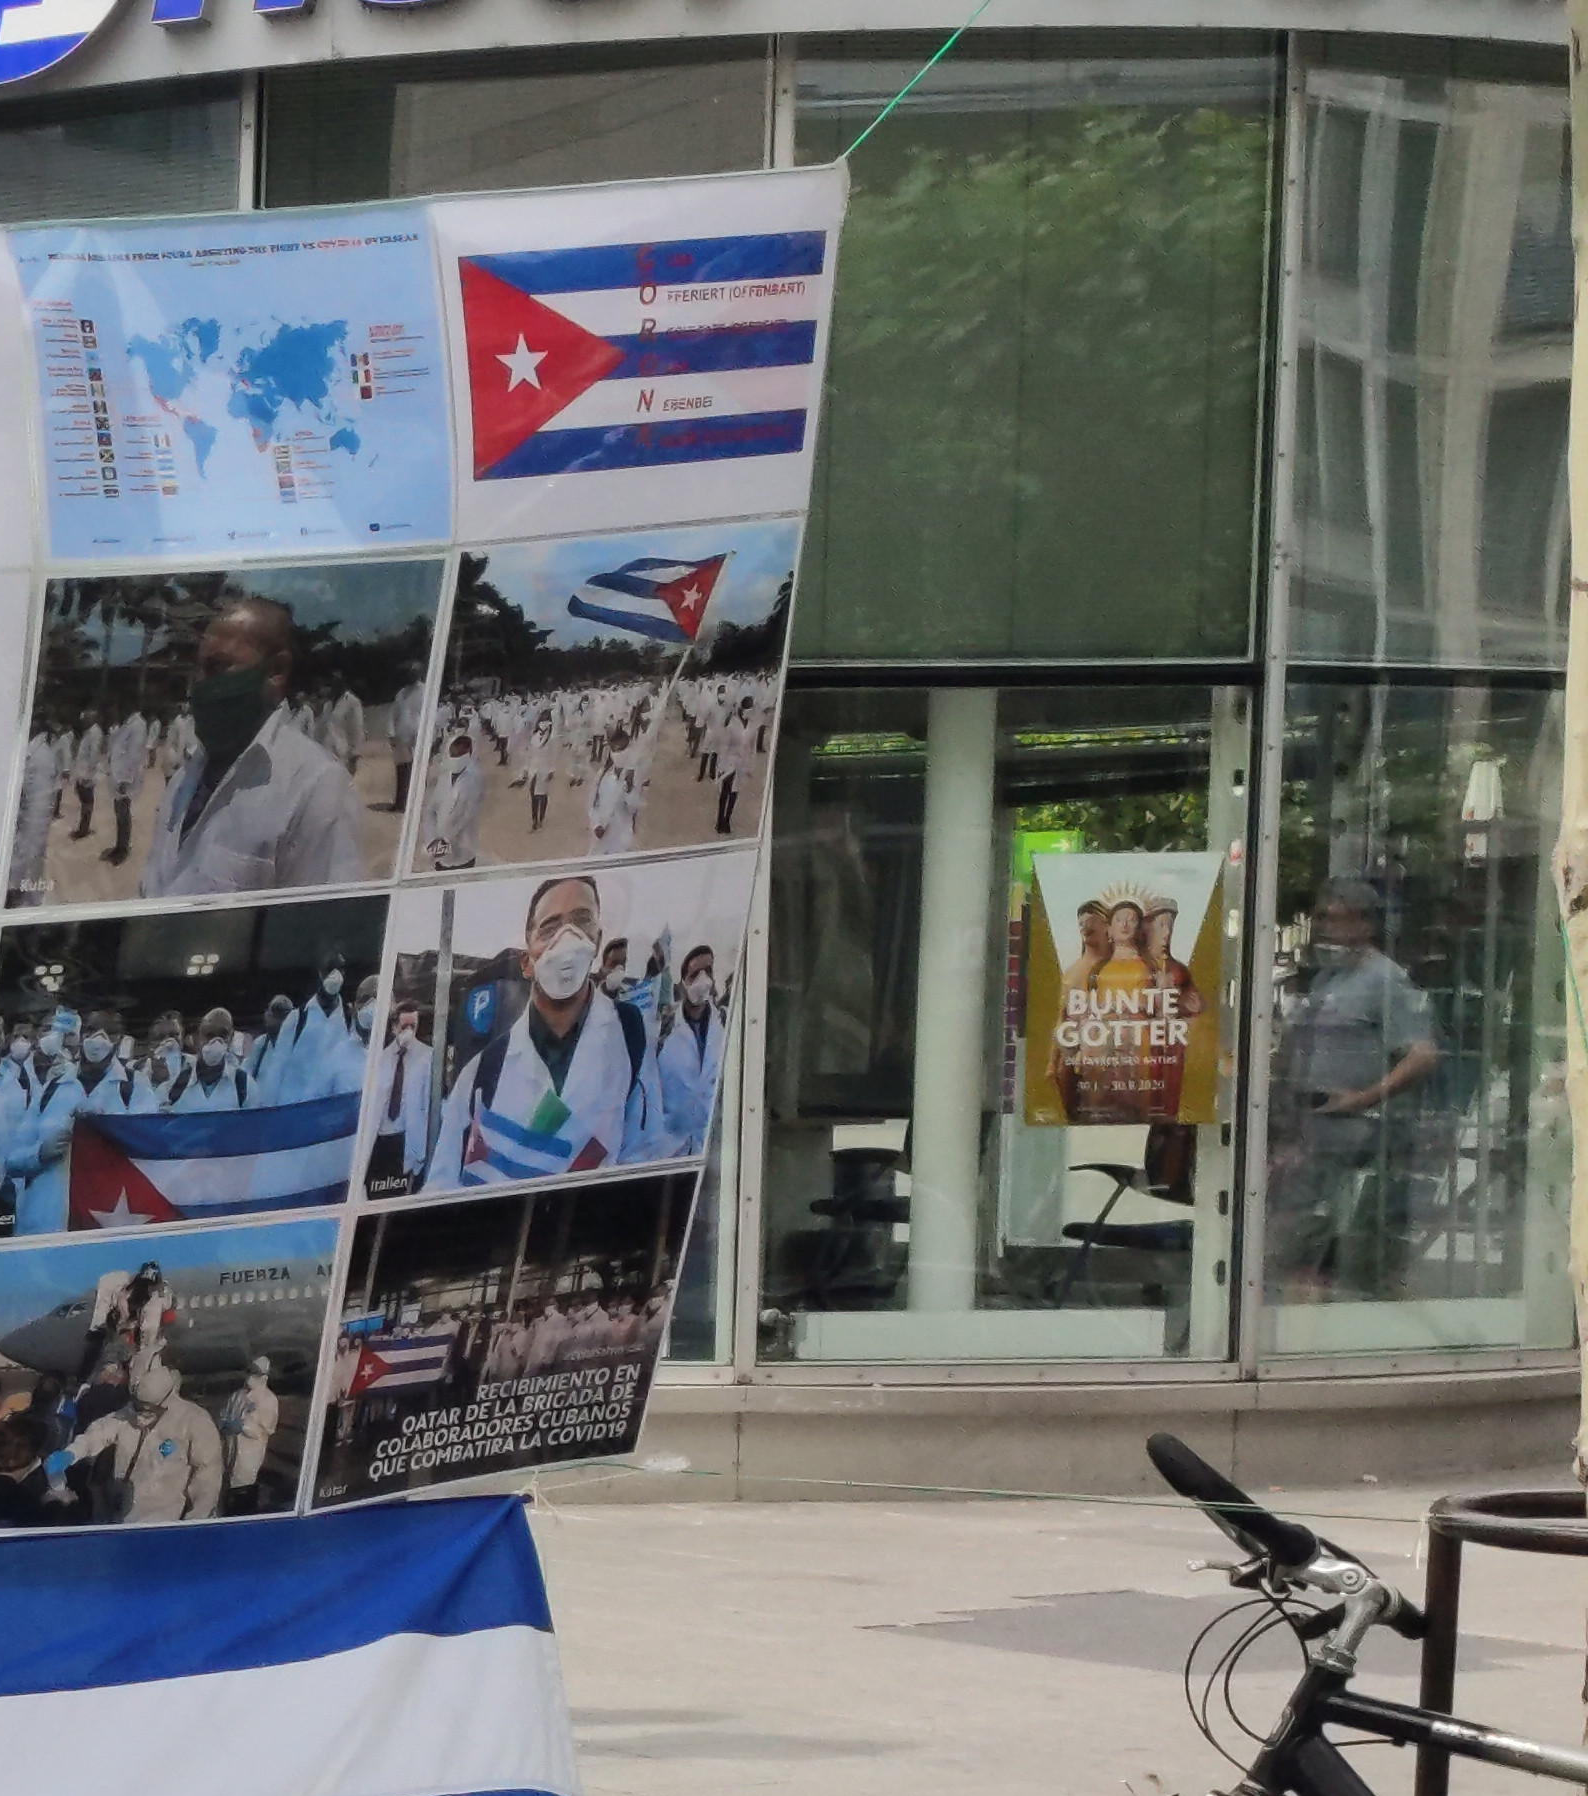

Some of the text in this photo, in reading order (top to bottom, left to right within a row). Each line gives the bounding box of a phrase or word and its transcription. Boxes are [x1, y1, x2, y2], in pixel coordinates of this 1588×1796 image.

[639, 282, 657, 305] O
[636, 389, 655, 413] N
[1067, 988, 1181, 1015] BUNTE
[1055, 1014, 1190, 1048] GÖTTER
[369, 1175, 410, 1195] Italien
[219, 1265, 292, 1287] FUERZA
[476, 1363, 642, 1401] RECIBIMIENTO EN
[402, 1382, 636, 1435] QATAR DE LA BRIGADA DE
[376, 1401, 632, 1460] COLABORADORES CUBANOS
[368, 1420, 628, 1483] QUE COMBATIRA LA COVID19
